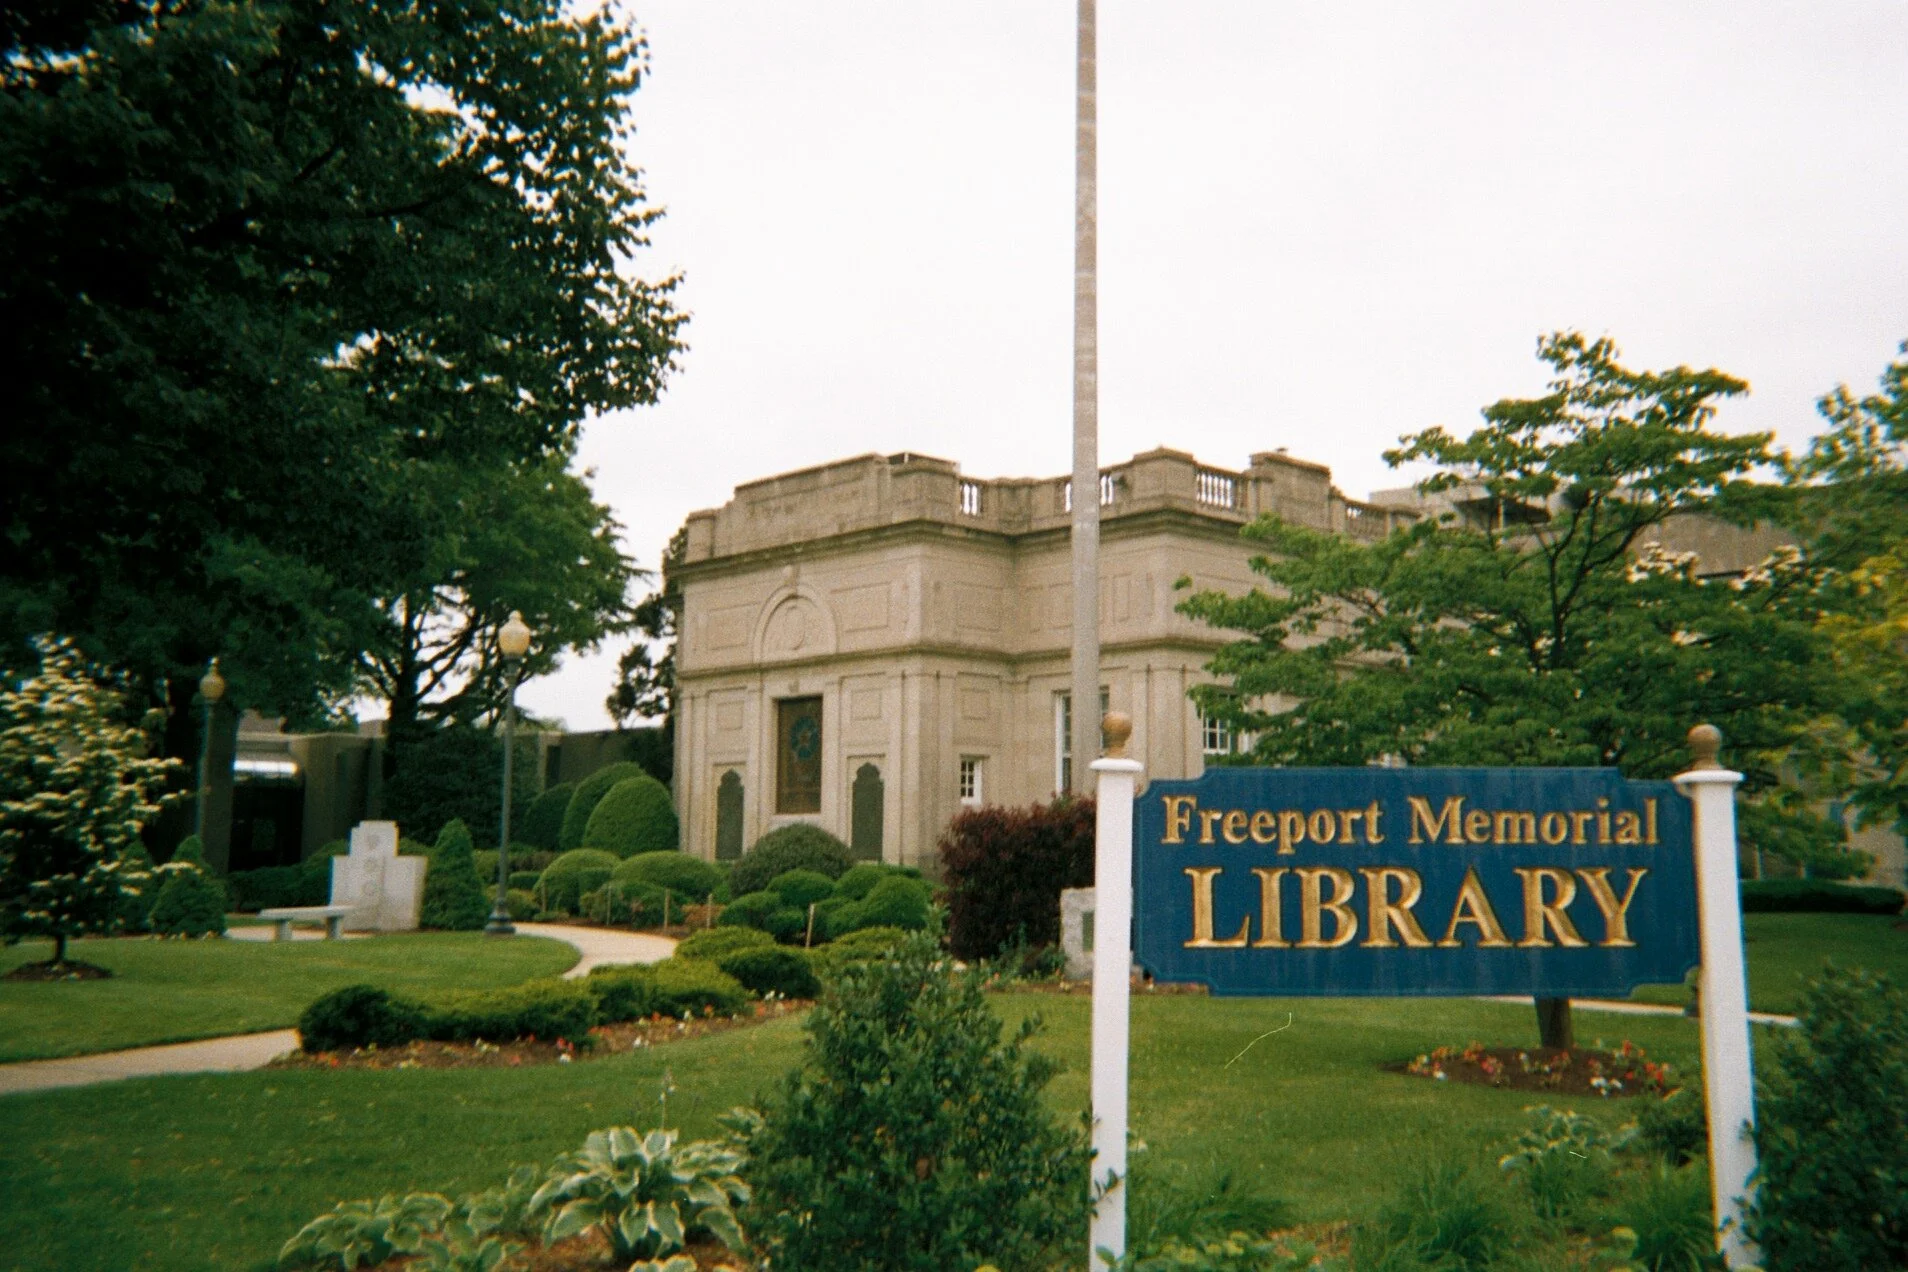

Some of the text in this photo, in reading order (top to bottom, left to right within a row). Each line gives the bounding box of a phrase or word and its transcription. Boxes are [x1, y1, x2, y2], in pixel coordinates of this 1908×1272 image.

[1161, 795, 1660, 854] Freeport Memorial
[1183, 865, 1649, 949] LIBRARY
